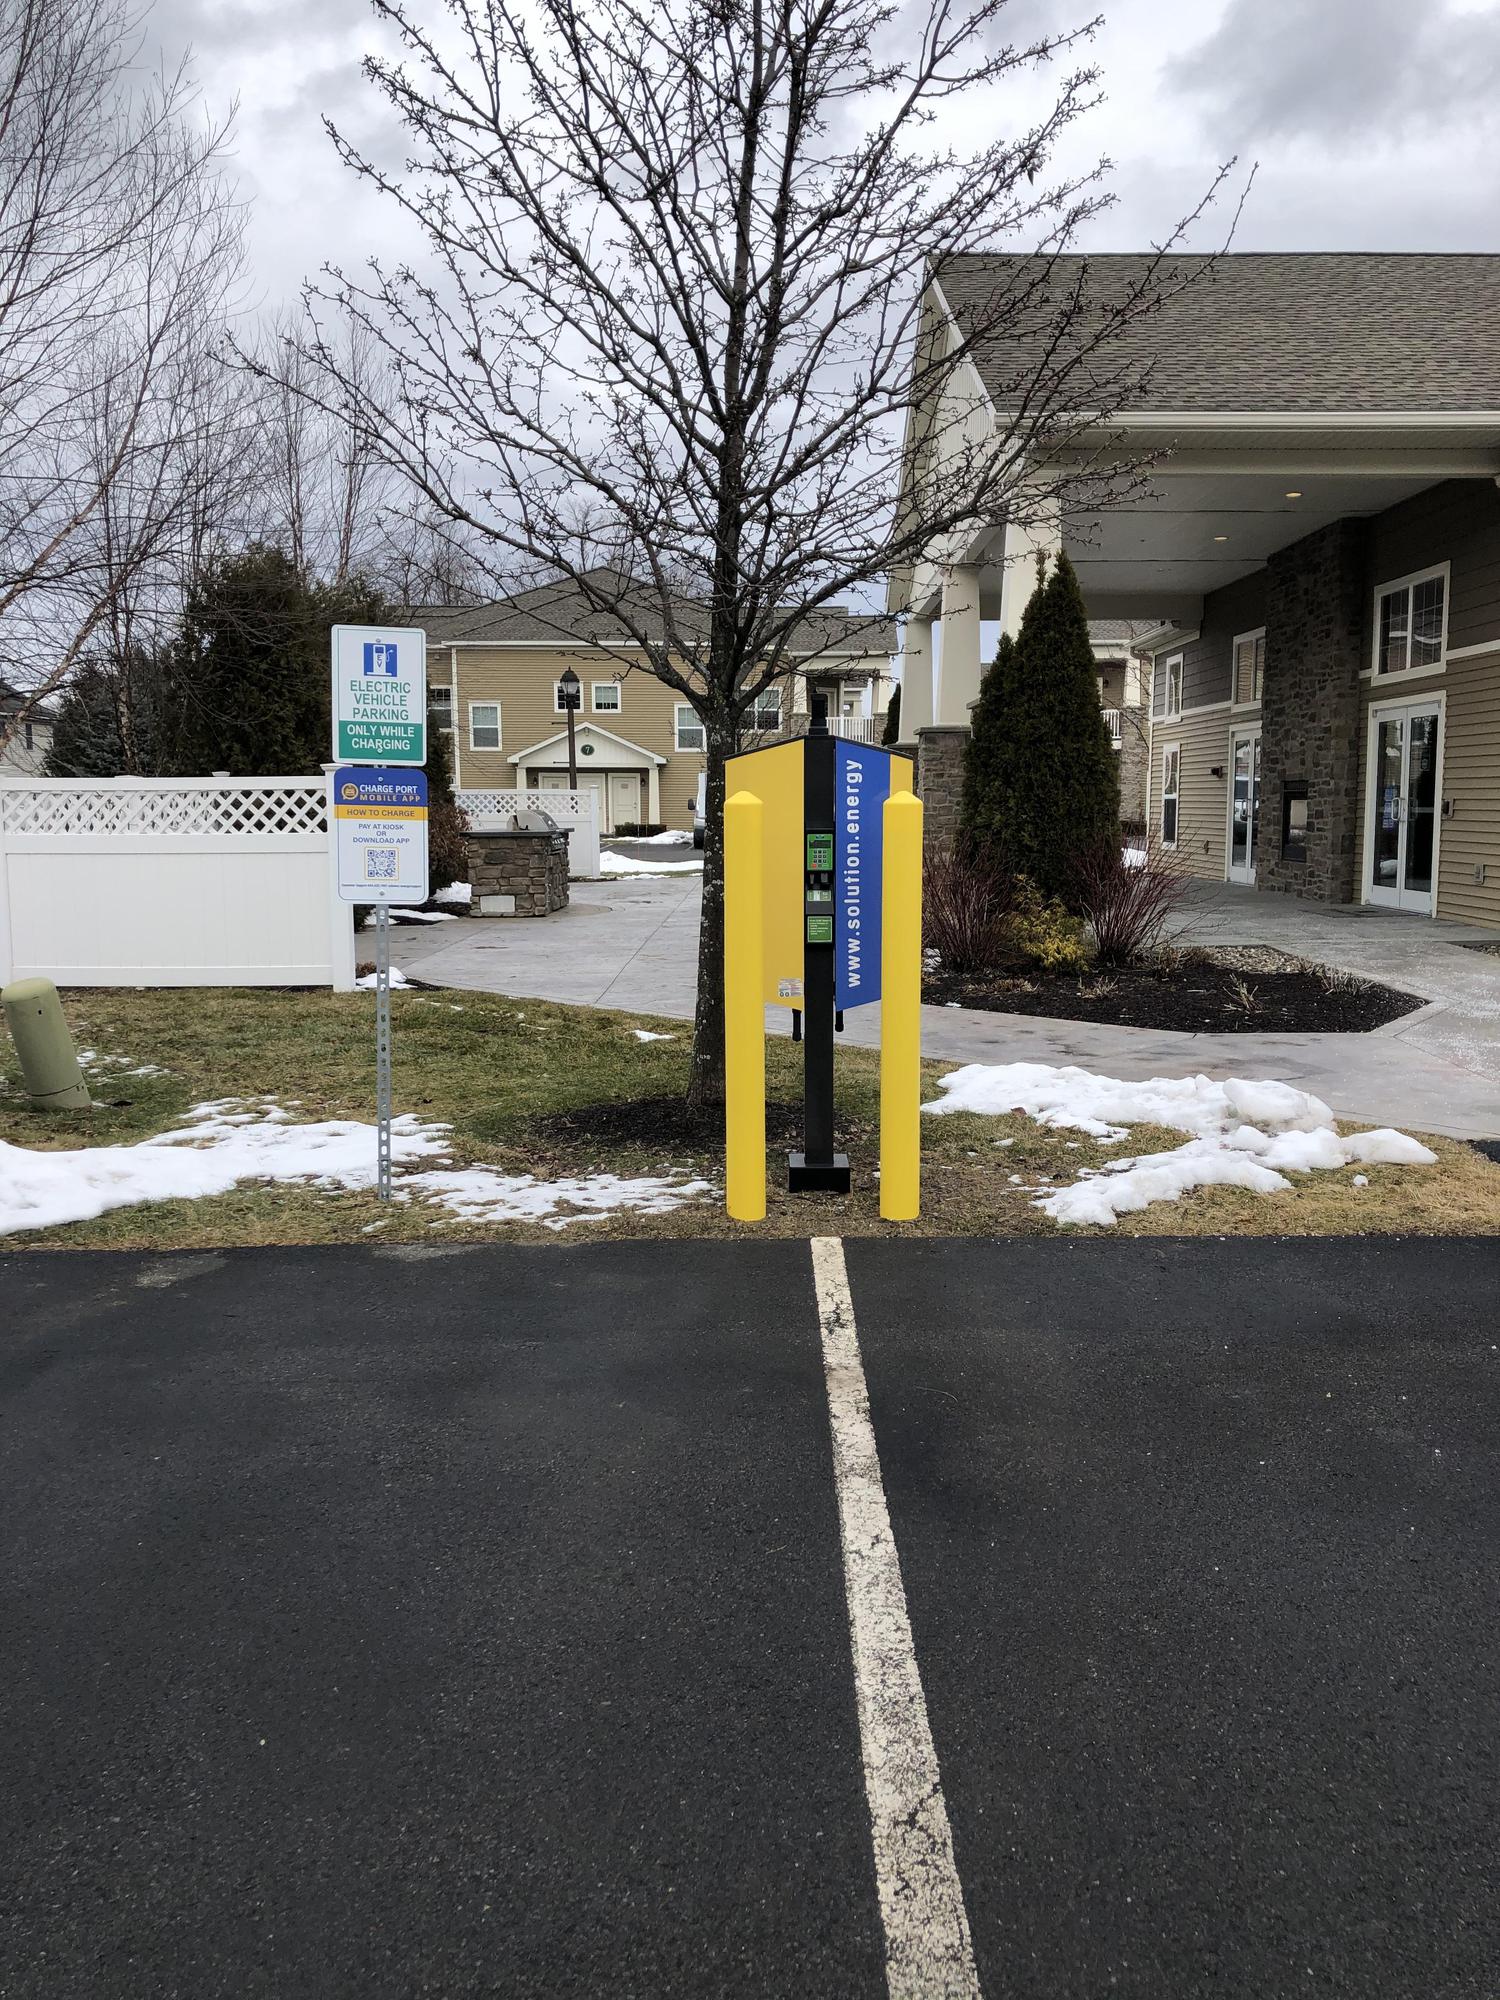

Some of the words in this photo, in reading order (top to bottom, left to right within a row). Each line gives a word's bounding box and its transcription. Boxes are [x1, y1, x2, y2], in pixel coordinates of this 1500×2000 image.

[350, 680, 411, 693] ELECTRIC
[354, 693, 407, 706] VEHICLE
[353, 708, 409, 720] PARKING
[347, 724, 377, 735] ONLY
[380, 725, 415, 737] WHILE
[352, 738, 410, 750] CHARGING
[360, 784, 394, 793] CHARGE
[396, 785, 418, 794] PORT
[360, 794, 397, 802] MOBILE
[382, 809, 415, 817] CHARGE
[844, 759, 862, 988] www.solution.energy
